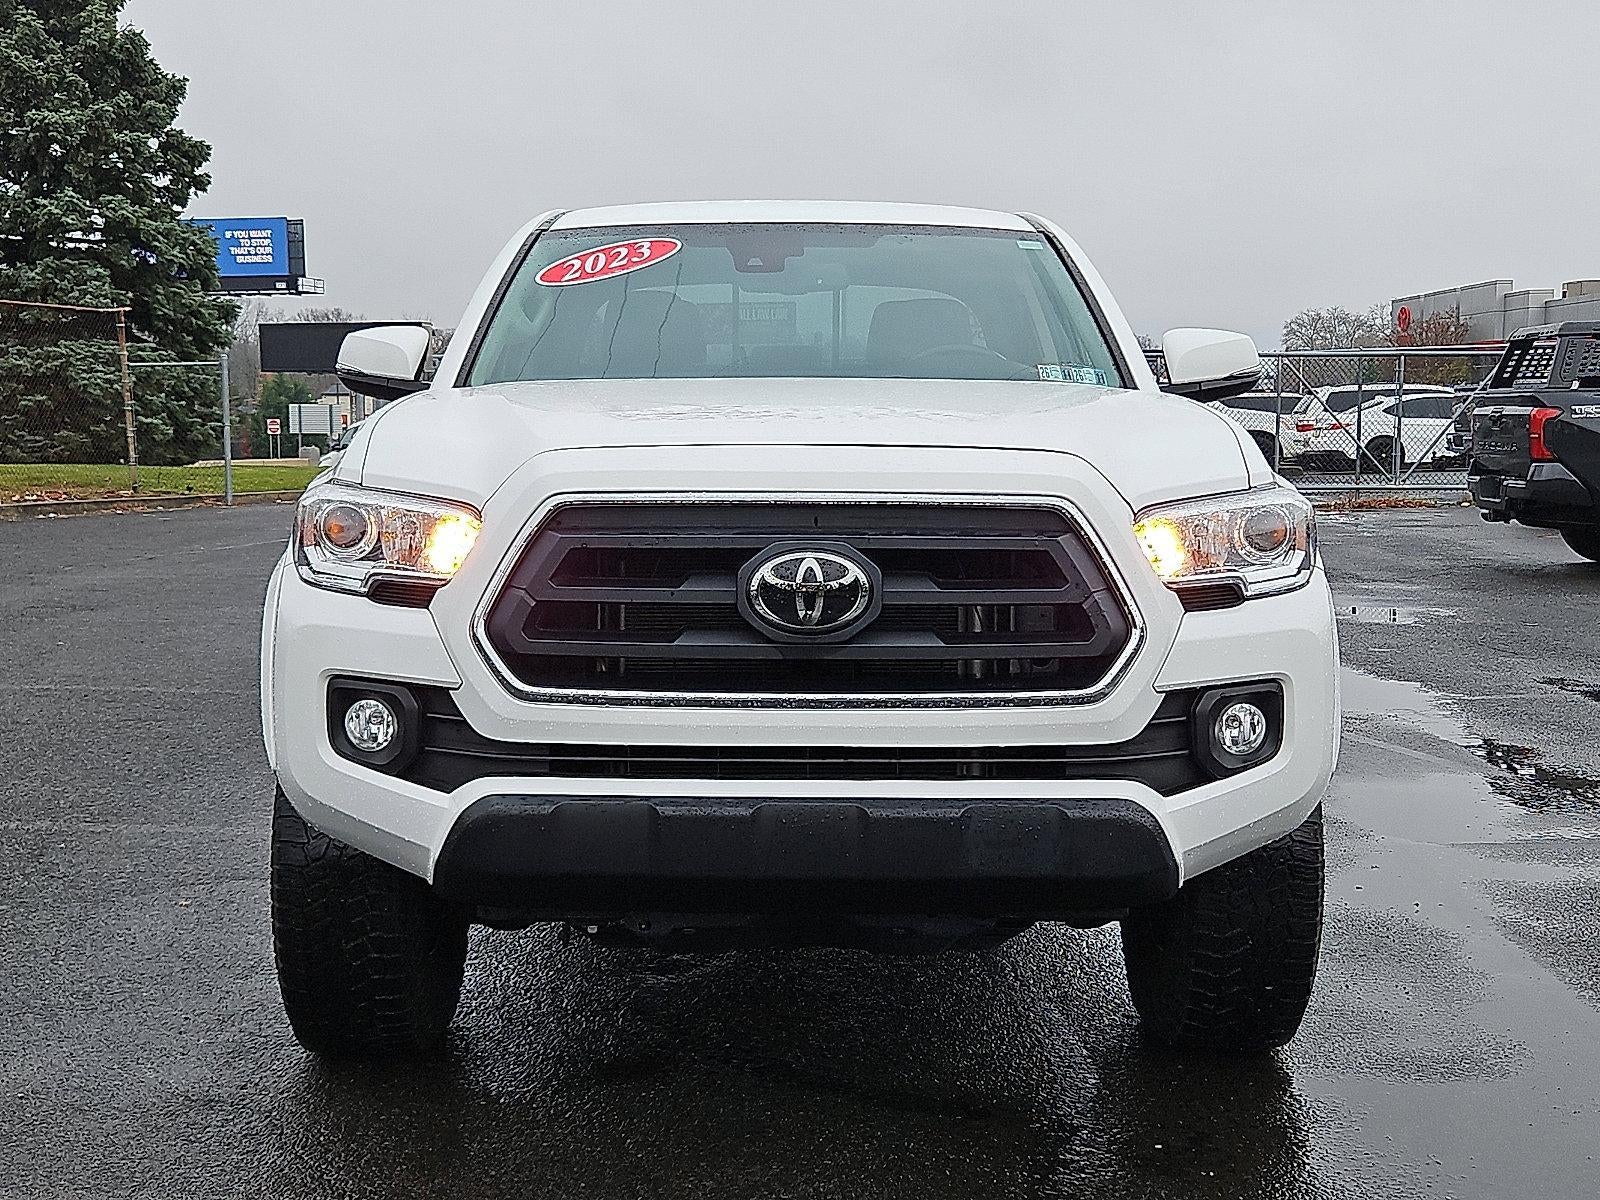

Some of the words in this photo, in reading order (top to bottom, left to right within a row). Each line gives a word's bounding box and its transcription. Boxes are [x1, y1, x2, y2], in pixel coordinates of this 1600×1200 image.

[225, 230, 232, 239] IF
[233, 230, 248, 238] YOU
[249, 229, 272, 238] WANT
[229, 247, 255, 255] THAT'S
[236, 255, 272, 263] BUSINESS
[560, 241, 652, 281] 2023
[1040, 366, 1050, 378] 26
